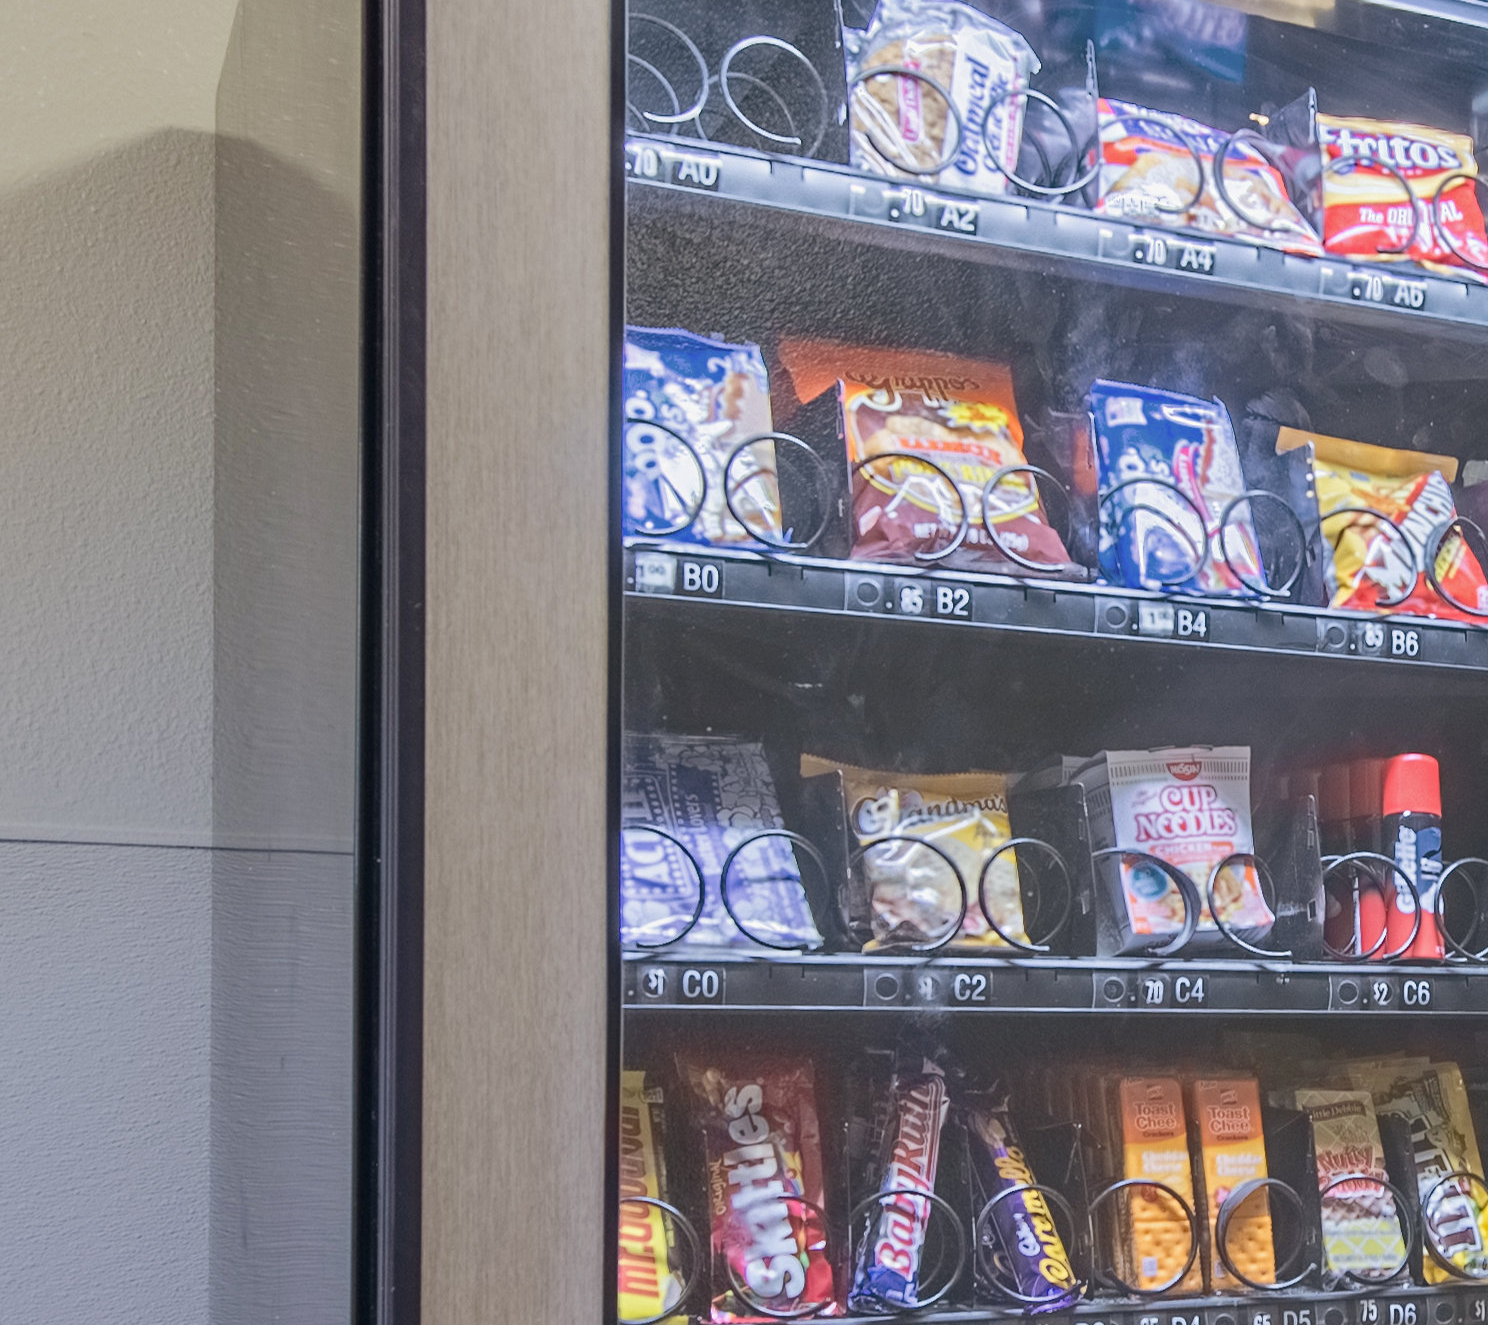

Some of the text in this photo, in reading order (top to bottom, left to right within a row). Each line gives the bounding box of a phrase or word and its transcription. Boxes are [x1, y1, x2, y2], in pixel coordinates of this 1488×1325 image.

[954, 54, 990, 176] Oatmeal
[1317, 125, 1463, 170] Fritos
[678, 159, 718, 186] A0
[940, 205, 975, 232] A2
[1359, 207, 1383, 224] The
[1179, 248, 1214, 272] A4
[1394, 284, 1424, 308] A6
[683, 562, 719, 593] B0
[936, 587, 970, 616] B2
[1177, 609, 1208, 638] B4
[1391, 630, 1419, 656] B6
[1170, 763, 1200, 775] NISSIN
[1160, 785, 1217, 811] CUP
[1136, 809, 1237, 843] NOODLES
[683, 970, 719, 998] C0
[954, 974, 986, 1000] C2
[1175, 978, 1205, 1002] C4
[1403, 981, 1430, 1006] C6
[1133, 1103, 1176, 1117] Toast
[1134, 1116, 1176, 1130] Chee
[1209, 1106, 1250, 1122] Toast
[1209, 1119, 1250, 1133] Chee
[1315, 1144, 1373, 1174] Nutty
[712, 1158, 727, 1216] Original
[723, 1084, 806, 1299] Skittles
[875, 1083, 932, 1277] Baby Ruth
[994, 1145, 1075, 1290] Caramello
